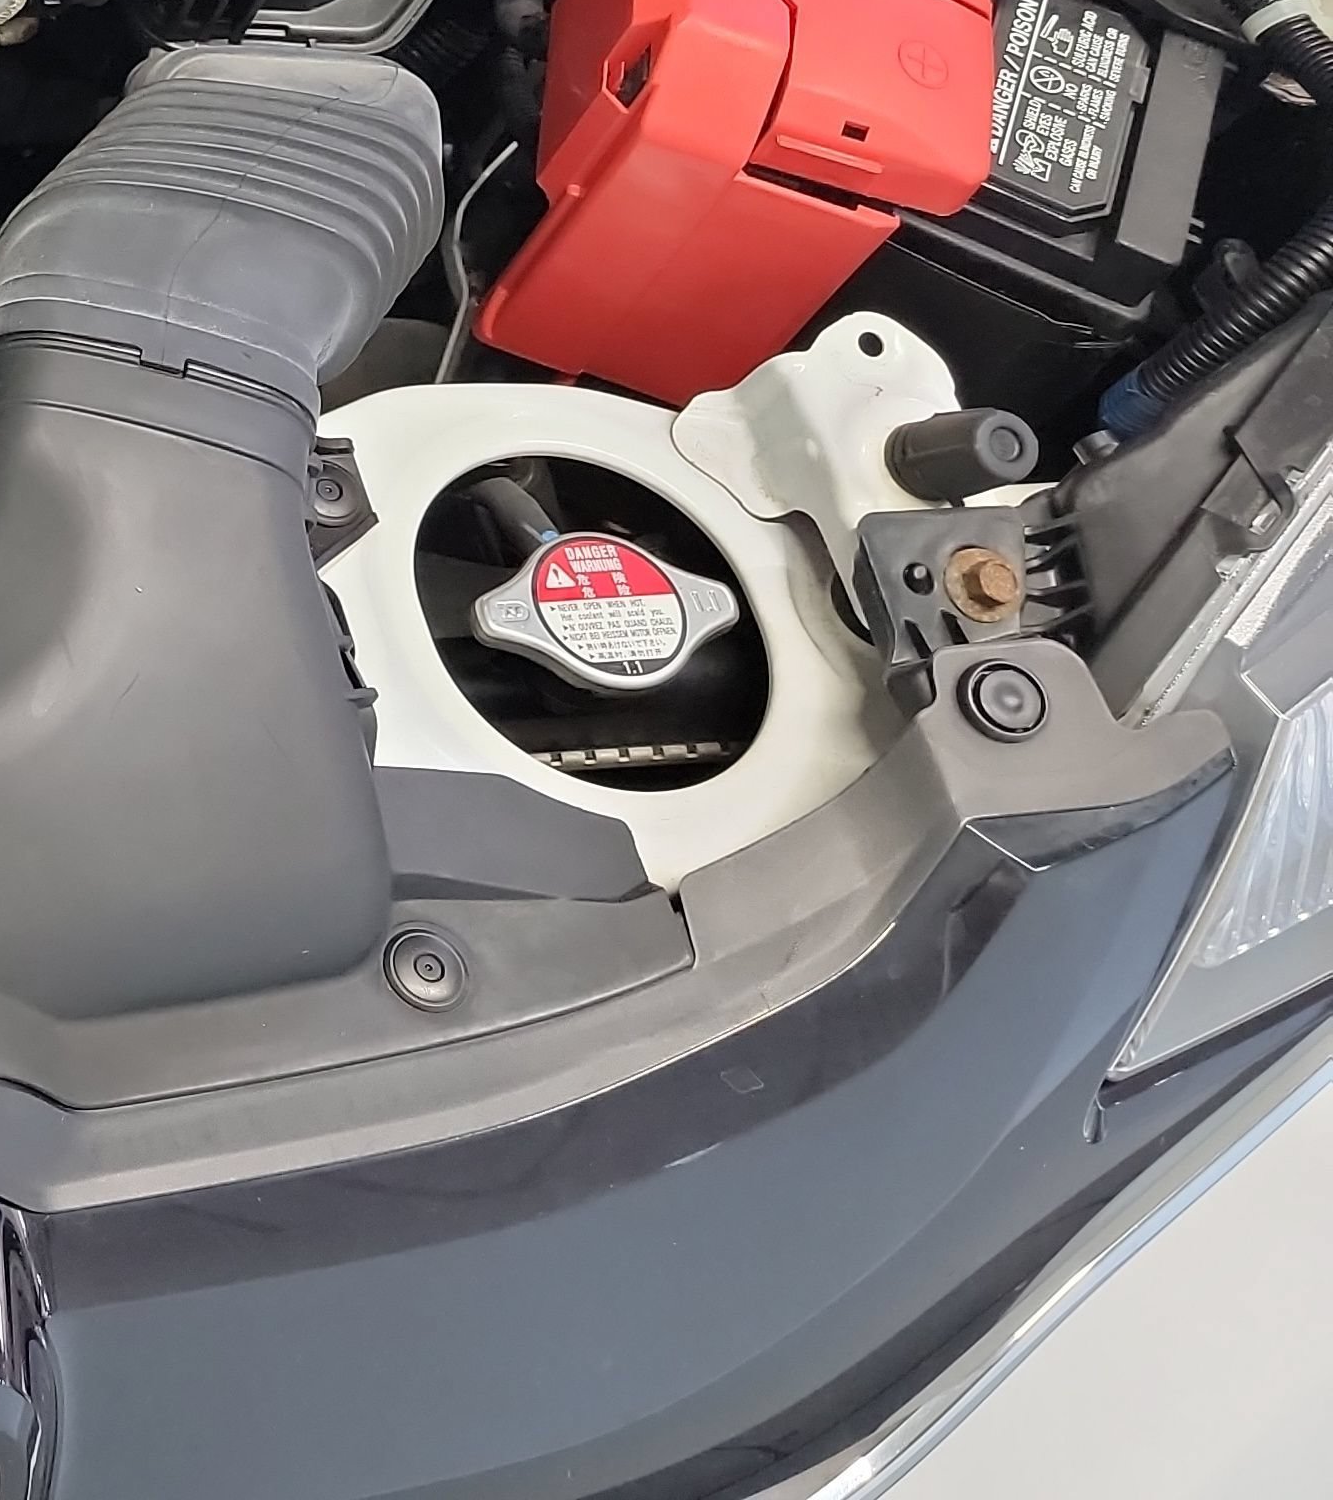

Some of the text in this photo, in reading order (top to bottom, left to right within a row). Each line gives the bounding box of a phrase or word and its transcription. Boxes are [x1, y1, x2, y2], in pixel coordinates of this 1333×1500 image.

[1073, 10, 1097, 68] SULFURIC ACID
[1084, 34, 1104, 73] CAN CAUSE
[1109, 55, 1124, 82] SEVERE
[1063, 83, 1078, 100] NO
[1088, 88, 1103, 115] FLAMES
[1023, 99, 1041, 130] SHIELD
[1037, 112, 1052, 136] EYES
[1045, 115, 1068, 161] EXPLOSIVE
[1059, 139, 1077, 167] GASES
[564, 544, 619, 561] DANGER
[569, 558, 623, 573] WARNUNG
[557, 603, 579, 611] NEVER
[583, 602, 602, 610] OPEN
[606, 600, 627, 608] WHEN
[578, 611, 604, 620] coolant
[607, 619, 622, 629] PAS
[622, 660, 644, 675] 1.1
